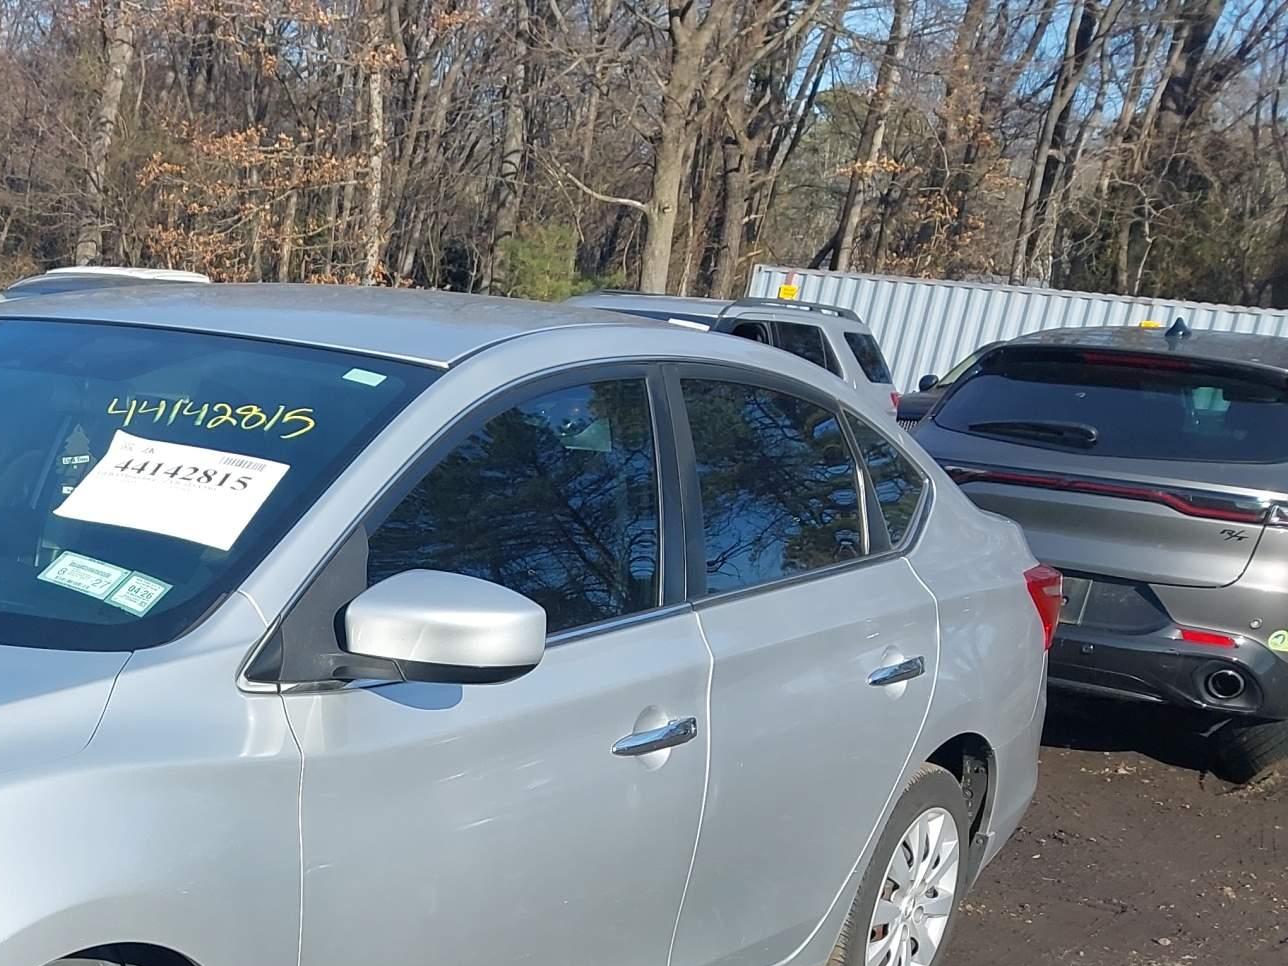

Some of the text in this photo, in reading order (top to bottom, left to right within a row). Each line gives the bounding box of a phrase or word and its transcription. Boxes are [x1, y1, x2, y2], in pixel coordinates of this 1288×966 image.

[107, 398, 316, 439] 44142815
[113, 458, 253, 491] 44142815
[91, 578, 111, 589] 27
